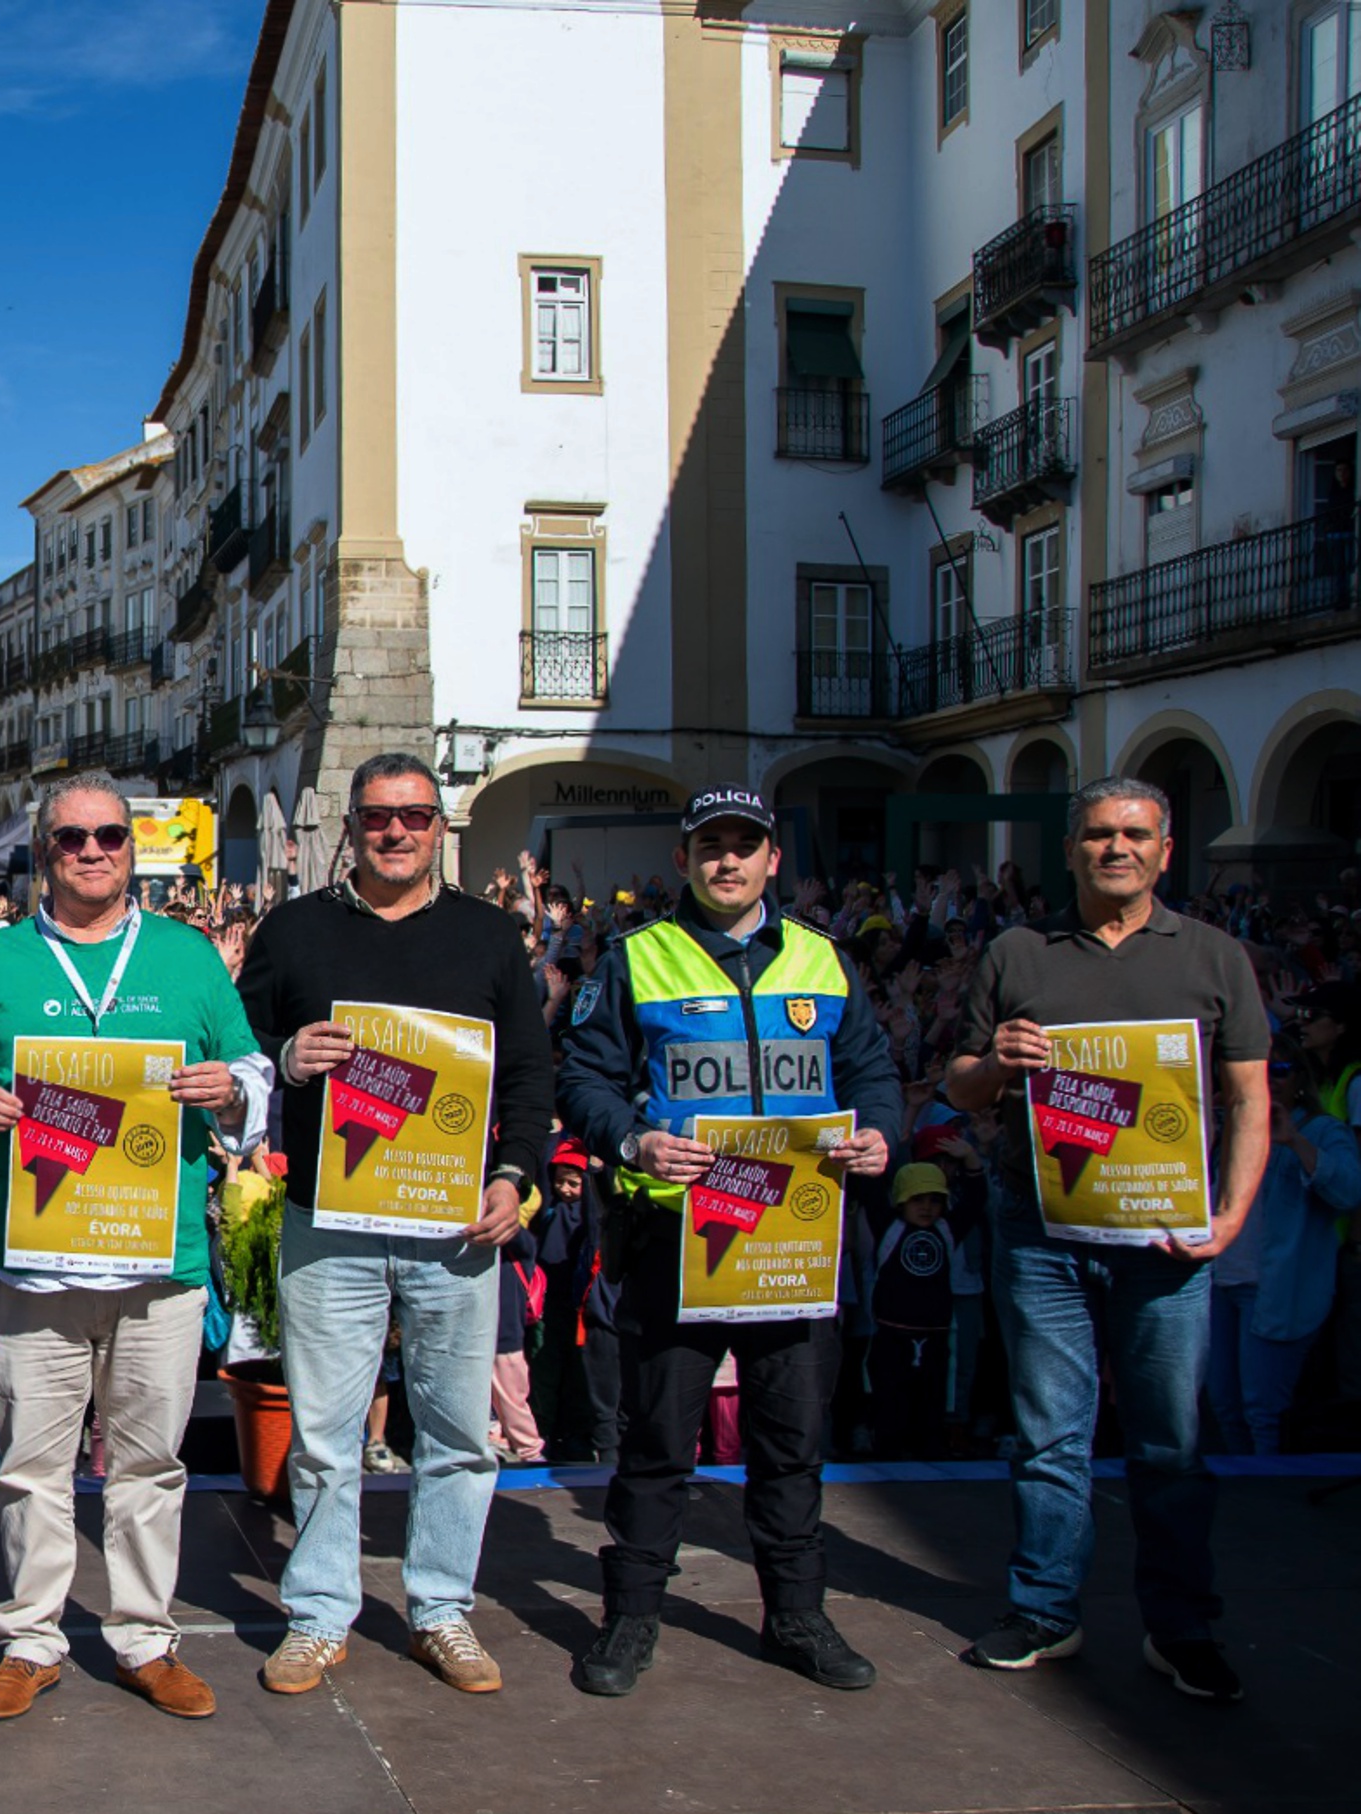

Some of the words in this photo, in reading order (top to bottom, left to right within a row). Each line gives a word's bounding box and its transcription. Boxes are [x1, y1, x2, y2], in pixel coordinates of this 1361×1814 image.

[555, 780, 669, 804] Millennium
[692, 789, 763, 813] POLÍCIA
[121, 1004, 162, 1014] CENTRAL
[27, 1049, 114, 1087] DESAFIO
[353, 1052, 377, 1073] PELA
[669, 1046, 824, 1097] POLÍCIA
[345, 1067, 395, 1101] DESPORTO
[401, 1092, 423, 1112] PAZ
[1053, 1074, 1078, 1093] PELA
[38, 1088, 63, 1108] PELA
[1048, 1091, 1100, 1118] DESPORTO
[1109, 1106, 1131, 1127] PAZ
[32, 1103, 81, 1133] DESPORTO
[91, 1123, 112, 1145] PAZ
[712, 1158, 736, 1175] PELA
[398, 1183, 448, 1202] ÉVORA
[705, 1172, 752, 1197] DESPORTO
[760, 1187, 779, 1205] PAZ
[1120, 1195, 1175, 1211] ÉVORA
[90, 1219, 142, 1237] ÉVORA
[758, 1273, 807, 1287] ÉVORA
